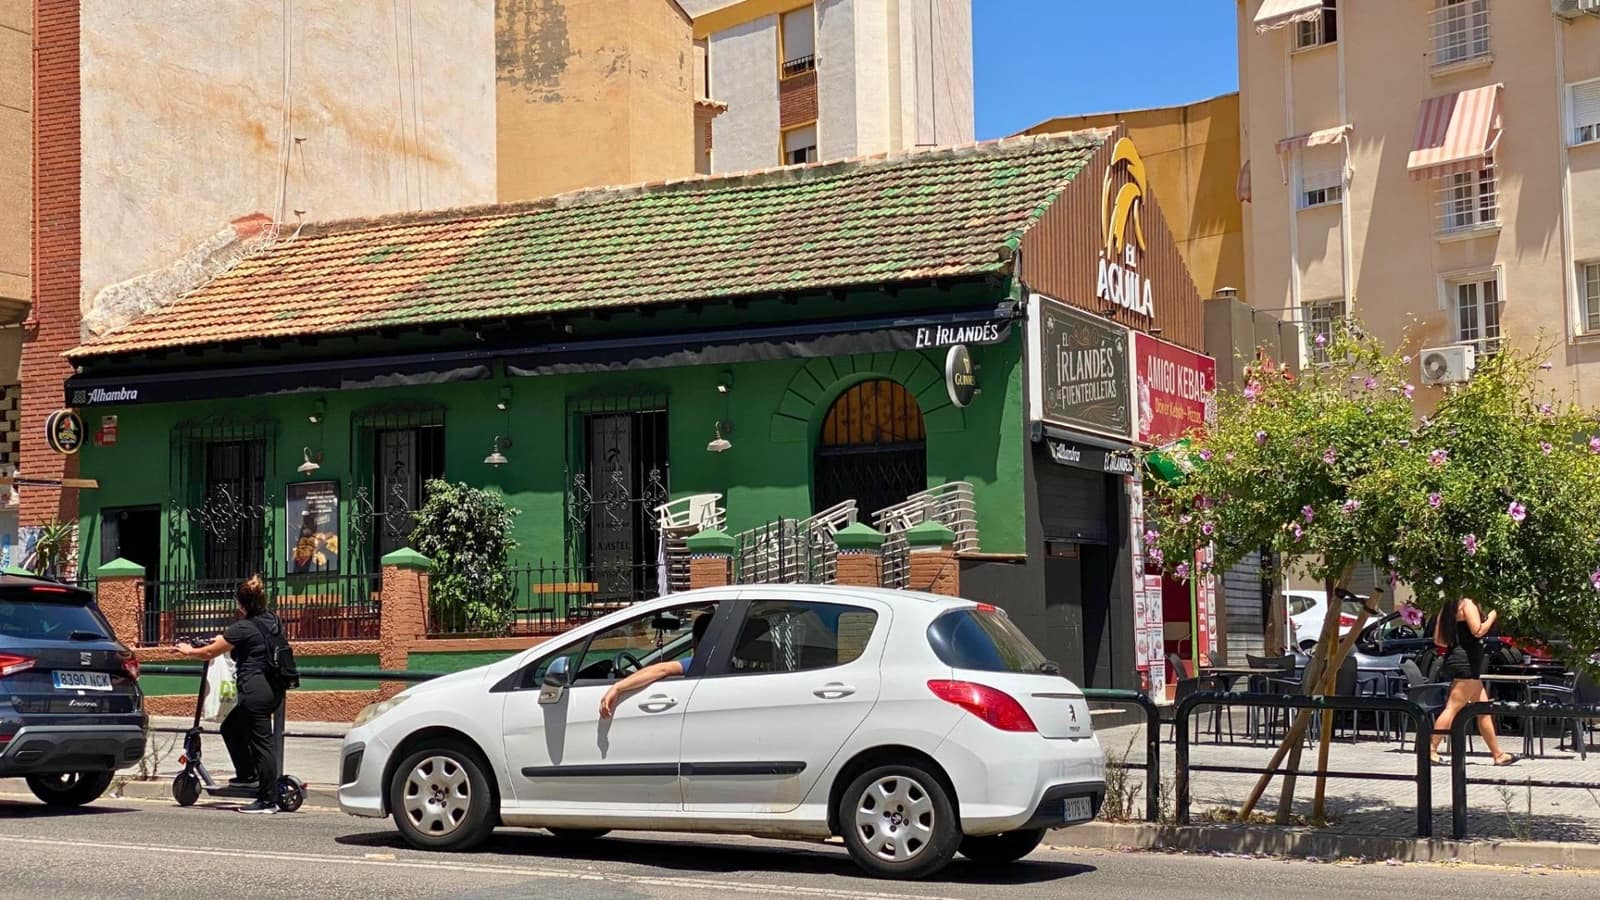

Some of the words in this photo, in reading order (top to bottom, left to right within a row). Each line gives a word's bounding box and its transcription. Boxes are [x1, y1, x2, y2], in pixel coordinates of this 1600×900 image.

[1125, 243, 1137, 268] EL
[915, 327, 932, 348] EL
[935, 321, 999, 346] IRLANDÉS
[1062, 332, 1069, 347] EL
[1056, 340, 1114, 386] IRLANDÉS
[1147, 354, 1176, 395] AMIGO
[1177, 364, 1206, 404] KEBAB
[87, 386, 138, 405] Alhambra
[1061, 379, 1117, 410] FUENTEOLLETAS
[1056, 443, 1081, 463] Alhambra
[60, 673, 86, 686] 8390
